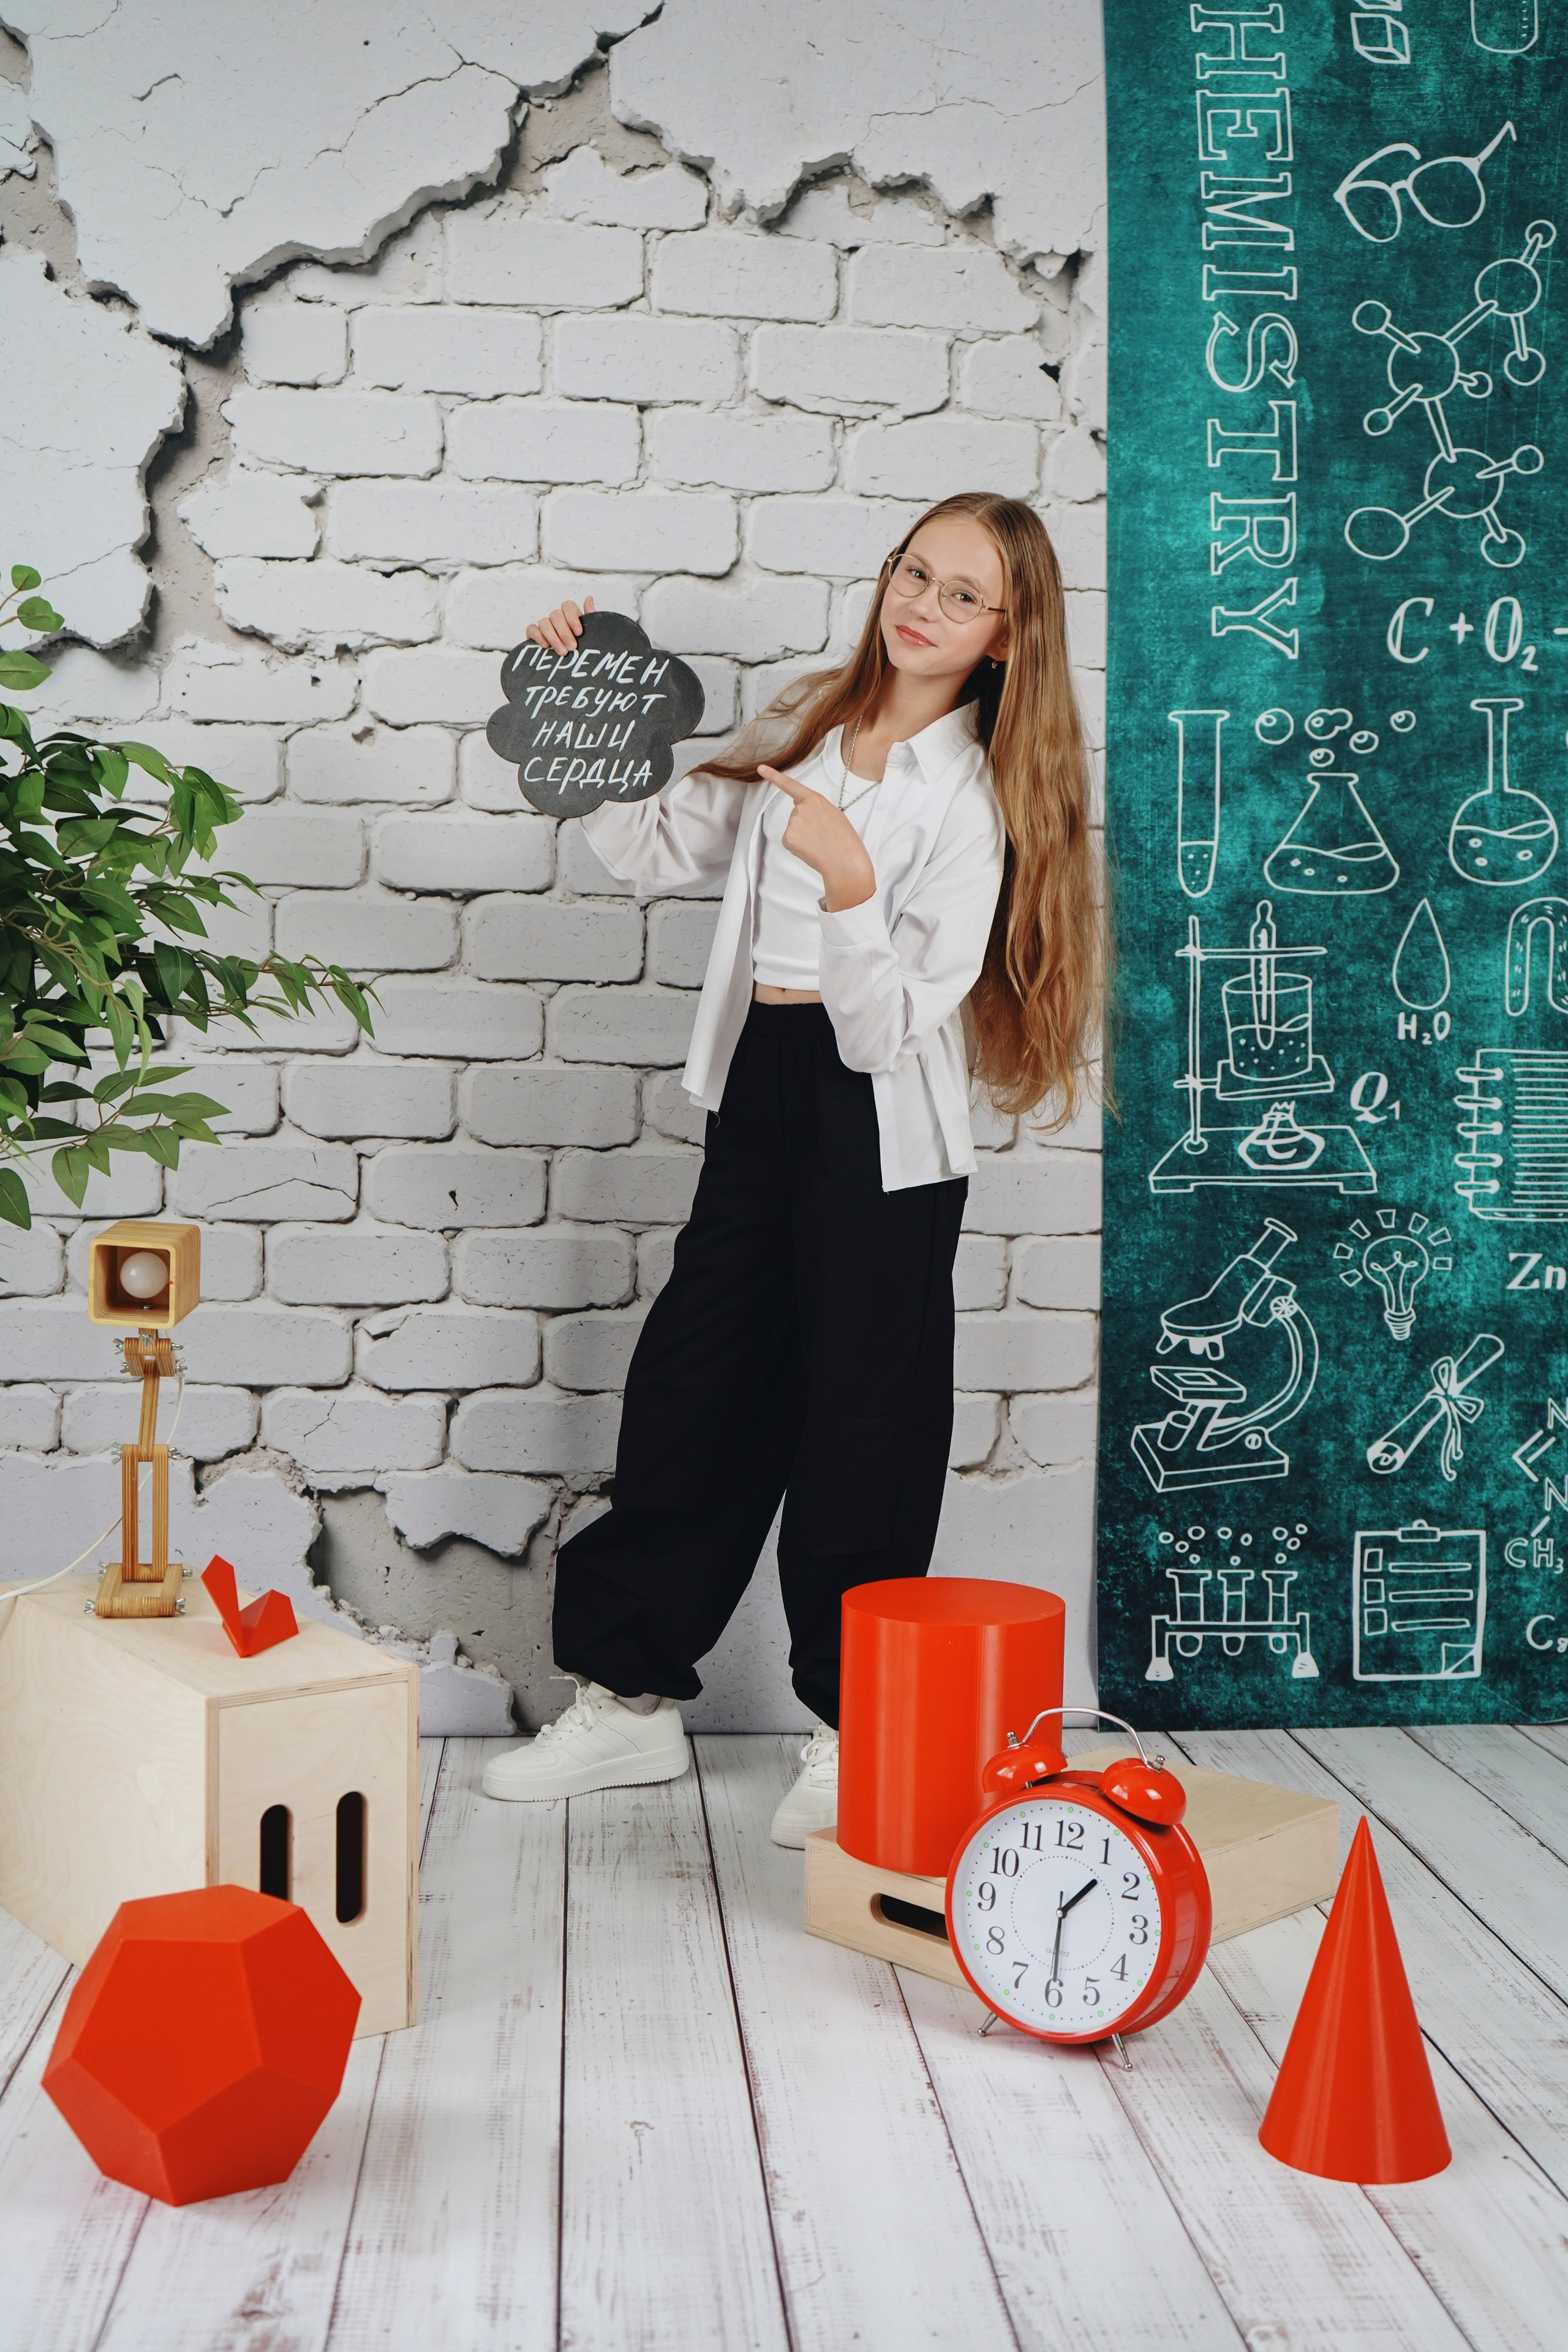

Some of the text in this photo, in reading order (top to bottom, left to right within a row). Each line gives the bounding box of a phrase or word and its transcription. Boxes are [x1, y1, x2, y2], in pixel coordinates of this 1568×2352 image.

[511, 644, 670, 687] ПЕРЕМЕН
[525, 685, 666, 719] ТРЕБУЮТ
[531, 720, 635, 752] НАШИ
[524, 757, 652, 795] СЕРДЦА
[1506, 1253, 1567, 1290] Zn
[1019, 1822, 1043, 1852] 11
[1055, 1820, 1084, 1850] 12
[990, 1847, 1019, 1877] 10
[1100, 1838, 1112, 1866] 1
[978, 1882, 996, 1911] 9
[1121, 1872, 1140, 1901] 2
[986, 1926, 1005, 1955] 8
[1129, 1915, 1148, 1945] 3
[1046, 1948, 1070, 1958] QURTZ
[1110, 1953, 1128, 1982] 4
[1012, 1961, 1029, 1989] 7
[1044, 1978, 1064, 2007] 6
[1082, 1977, 1101, 2006] 5
